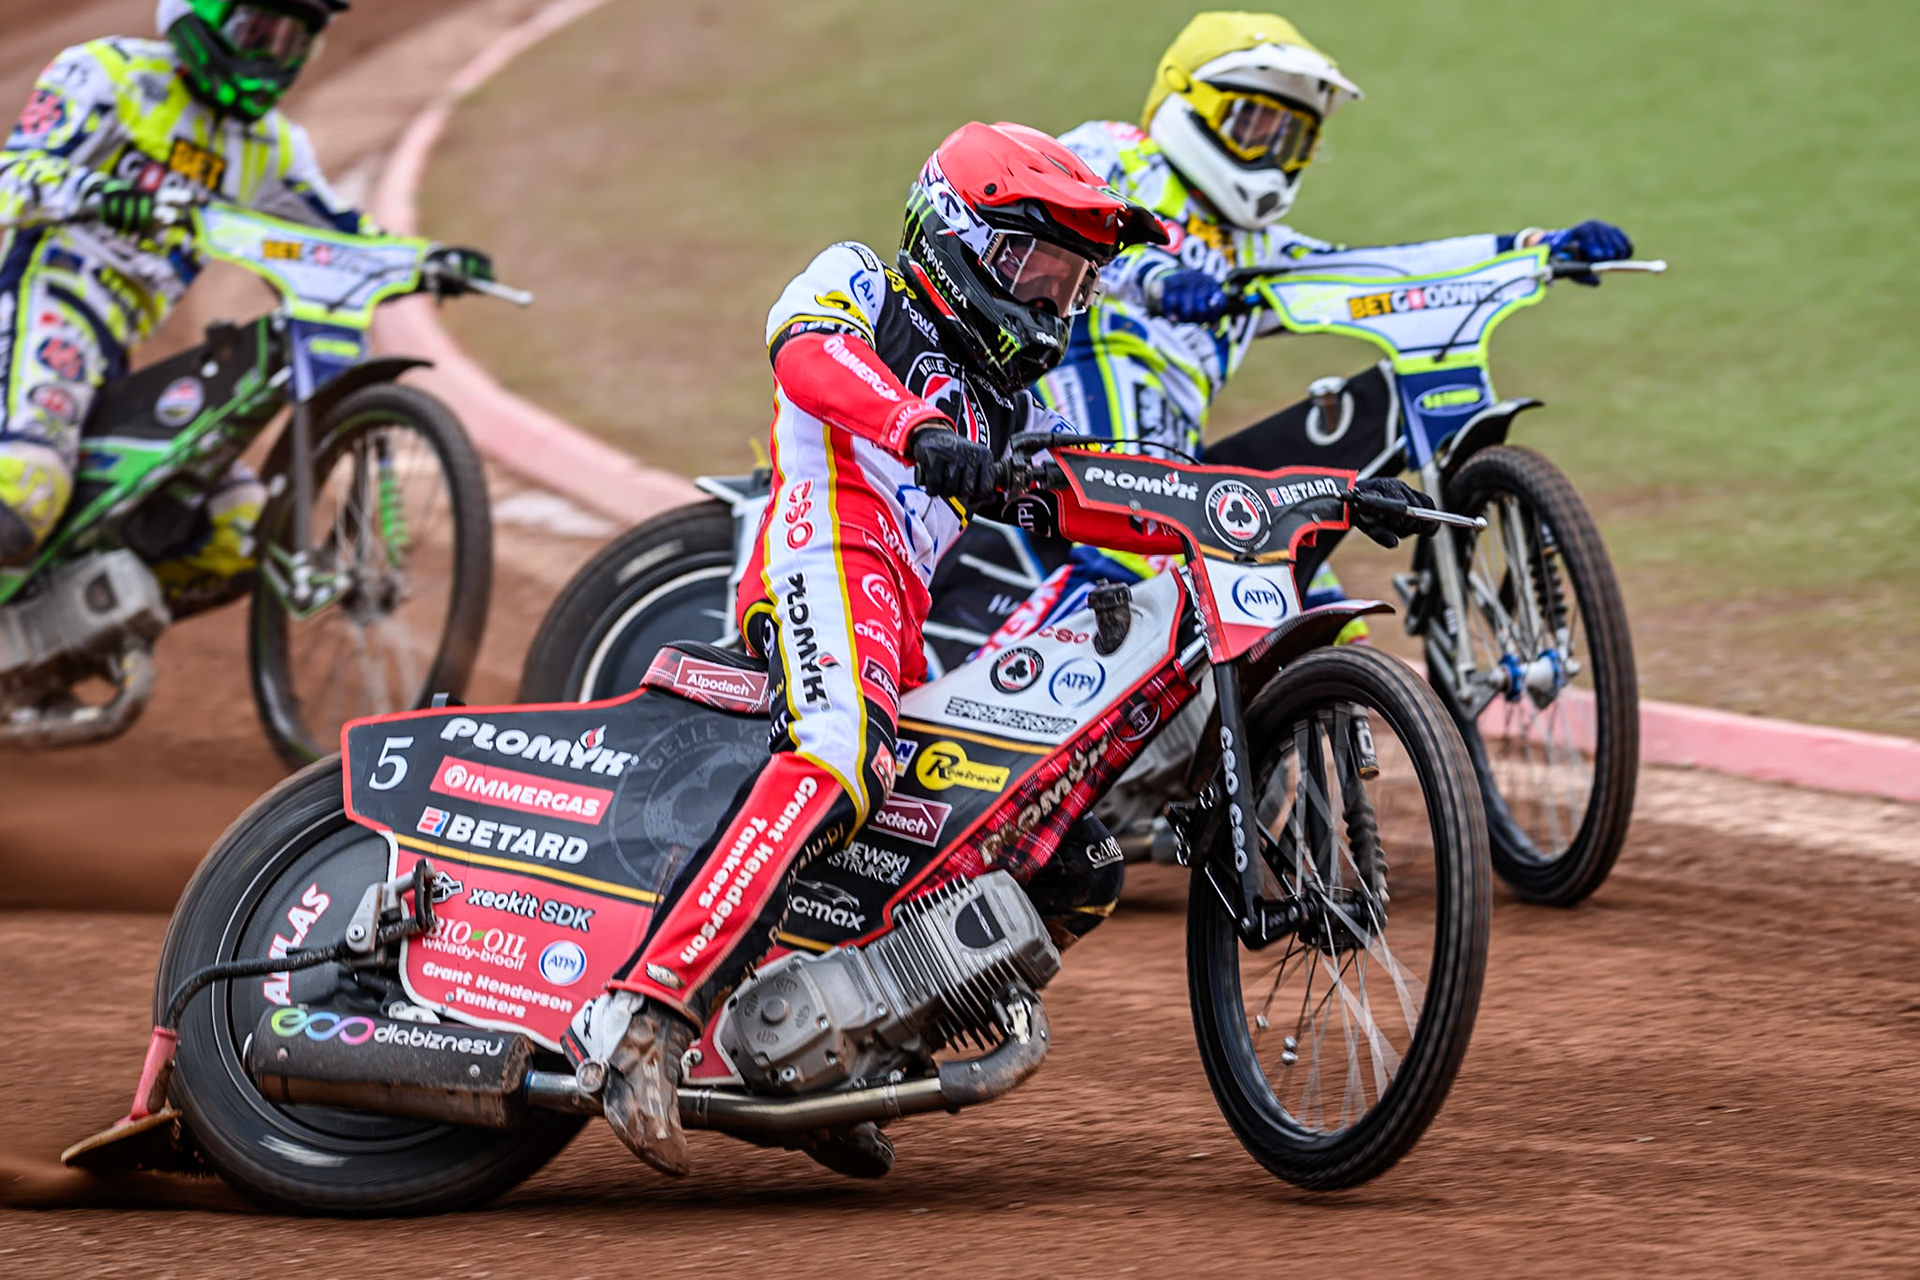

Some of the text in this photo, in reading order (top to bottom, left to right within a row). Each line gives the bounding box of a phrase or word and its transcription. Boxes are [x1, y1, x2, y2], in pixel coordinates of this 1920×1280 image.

[919, 235, 968, 309] MONSTER
[1278, 478, 1342, 505] BETARD
[1243, 588, 1279, 607] ATPI
[686, 672, 750, 697] Alpodach
[1057, 671, 1096, 692] ATPI
[368, 736, 414, 791] 5
[464, 774, 601, 817] IMMERGAS
[767, 776, 819, 844] Grant
[446, 814, 590, 864] BETARD
[698, 816, 768, 909] Tankers
[467, 888, 595, 932] xeokit SDK
[680, 843, 775, 965] Henderson
[548, 953, 578, 972] ATPI
[422, 961, 573, 1014] Grant Henderson
[455, 986, 527, 1019] Tankers
